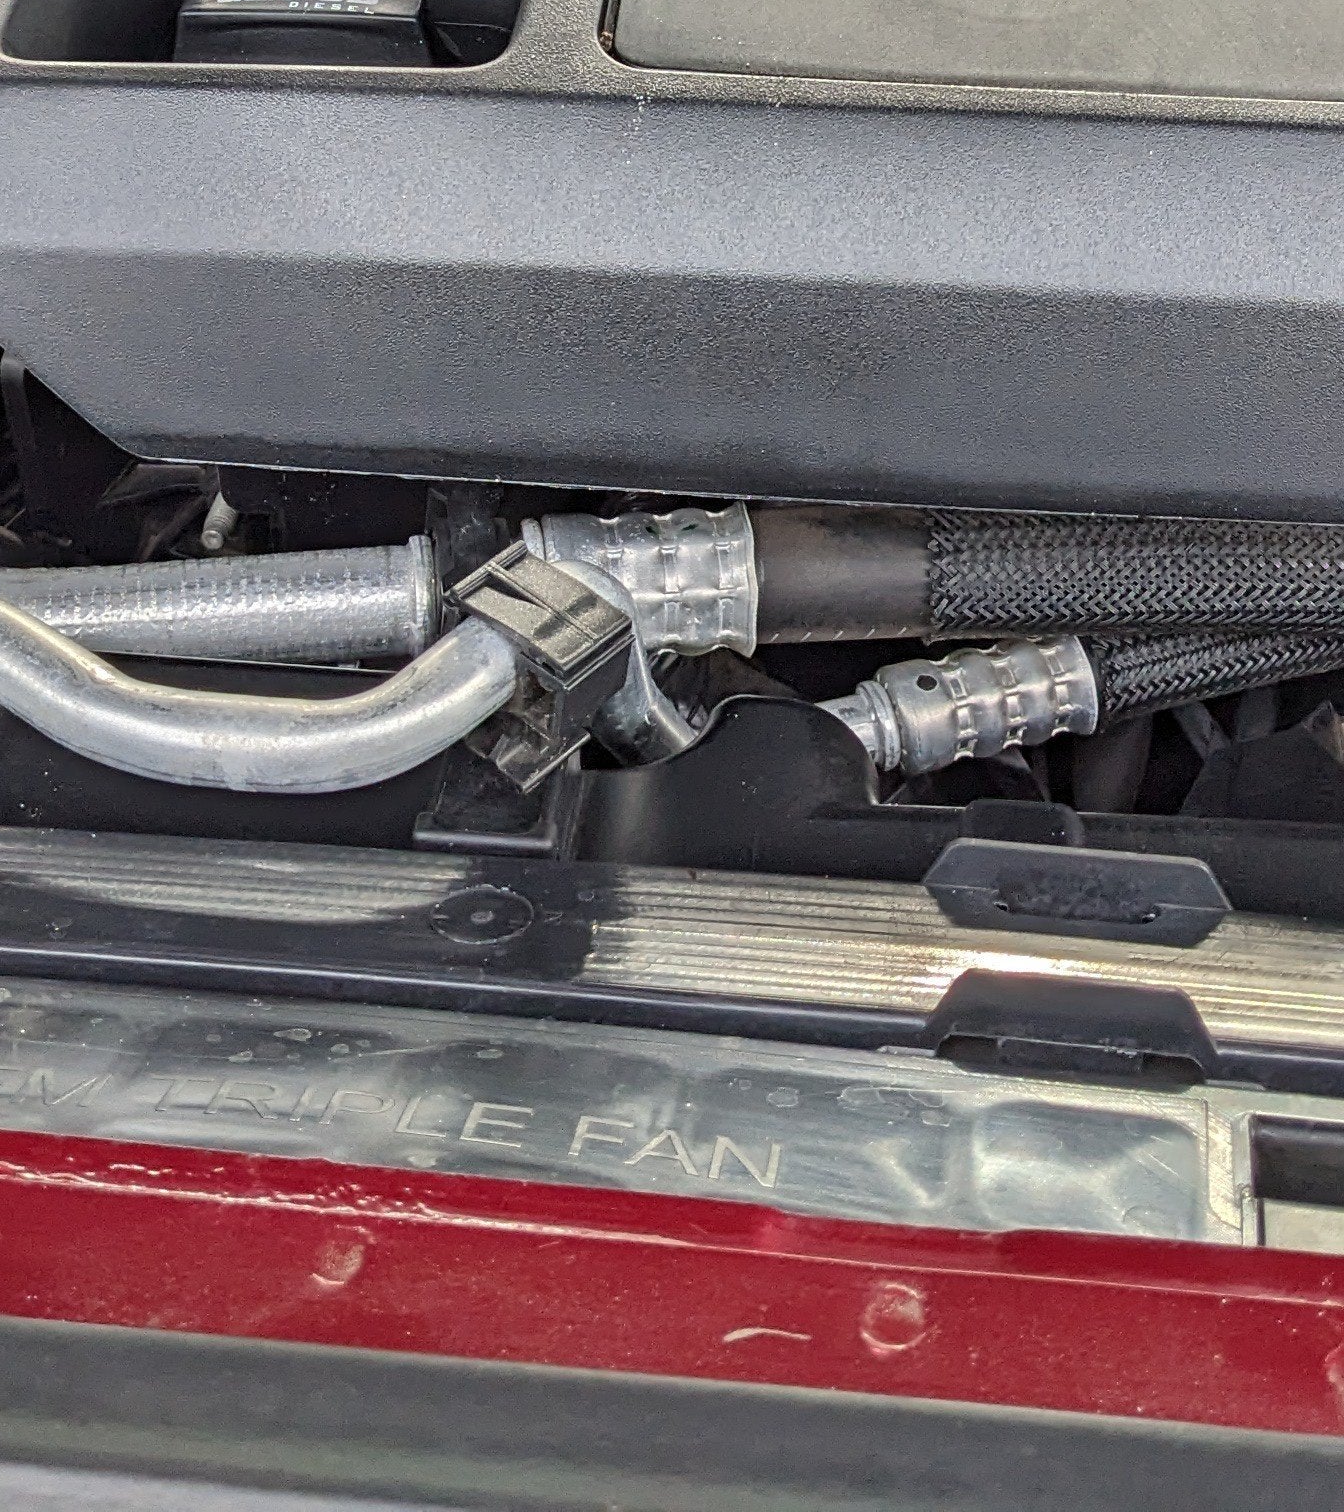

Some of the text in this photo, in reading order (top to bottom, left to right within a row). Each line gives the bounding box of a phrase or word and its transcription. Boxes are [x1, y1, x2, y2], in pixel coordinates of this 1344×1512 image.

[288, 1, 375, 15] DIESEL
[155, 1076, 536, 1149] TRIPLE
[568, 1114, 783, 1188] FAN
